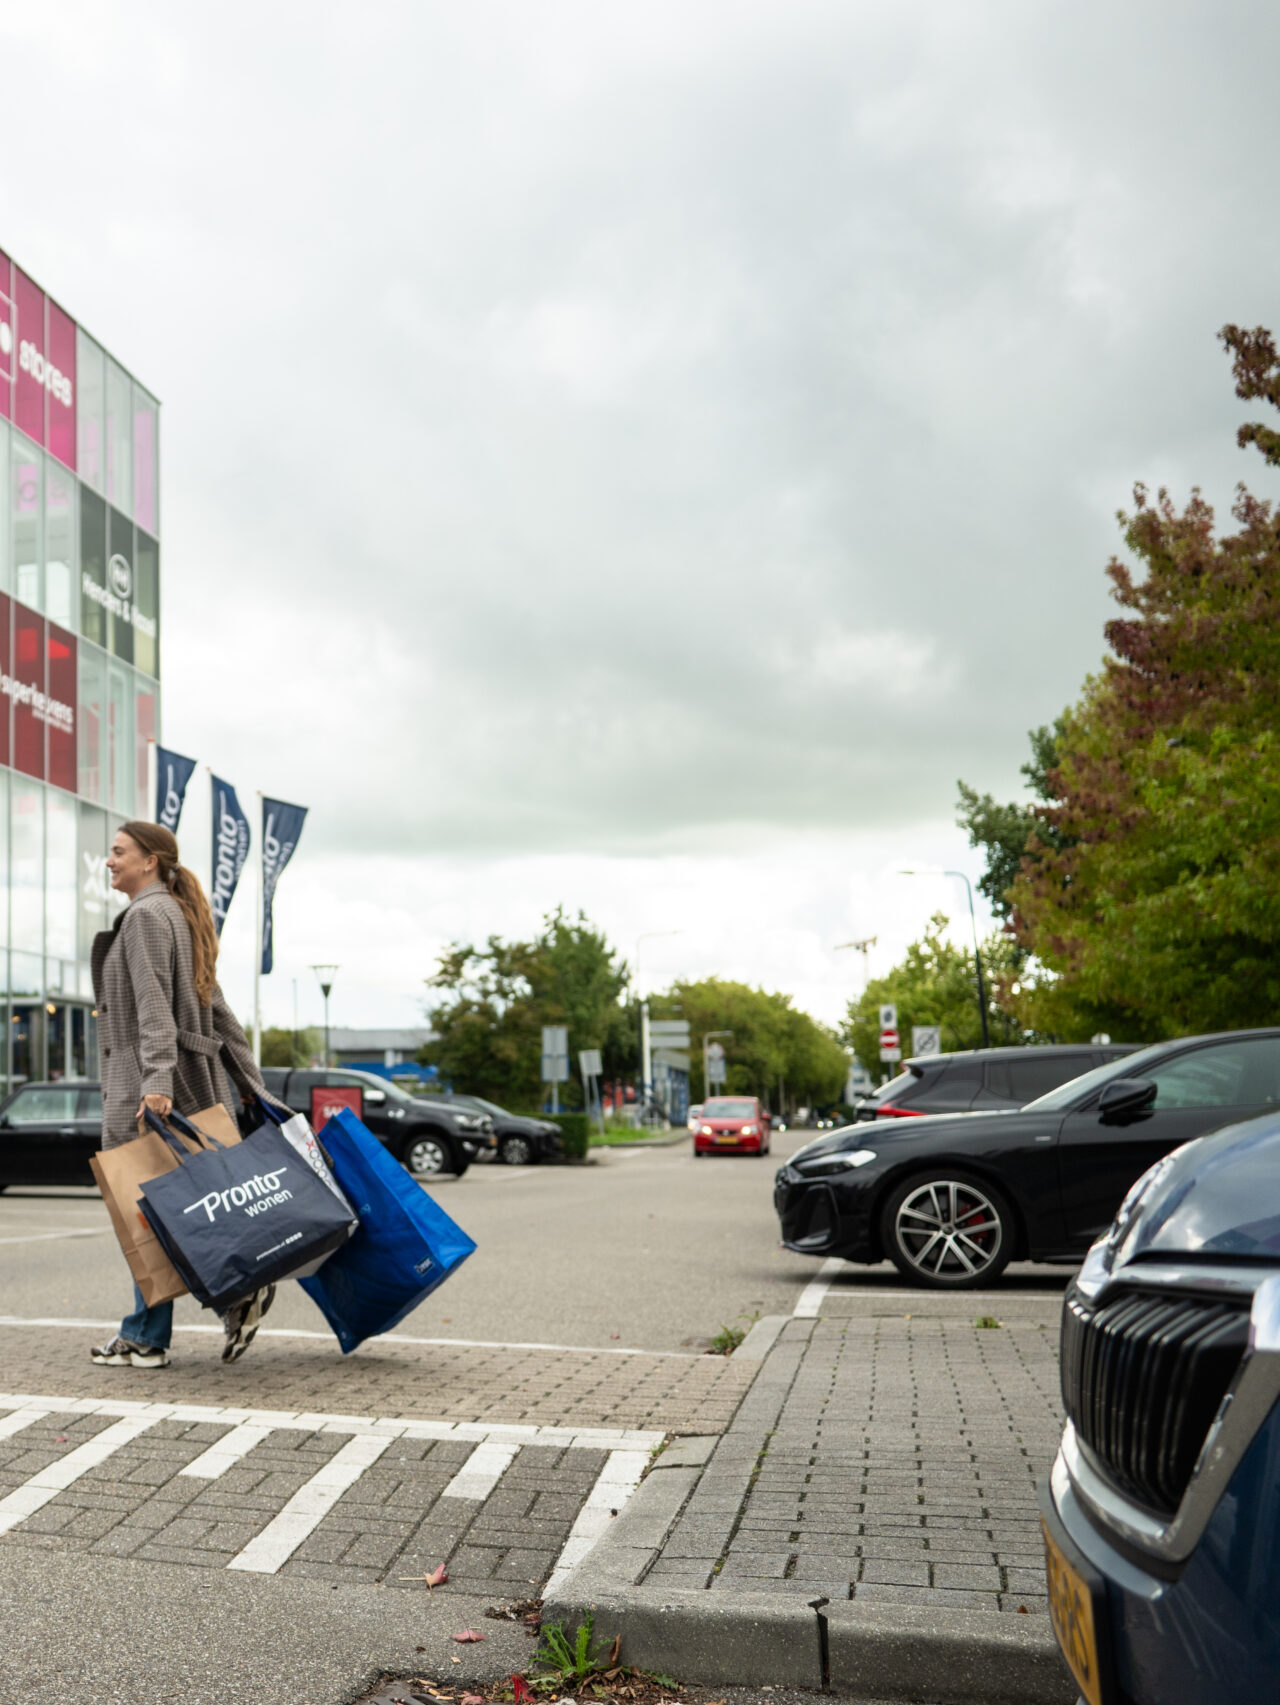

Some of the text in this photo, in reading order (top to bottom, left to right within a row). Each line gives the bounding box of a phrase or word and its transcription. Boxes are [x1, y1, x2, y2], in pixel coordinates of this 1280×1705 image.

[19, 339, 74, 408] stores
[212, 789, 238, 921] Pronto
[183, 1166, 288, 1223] Pronto
[244, 1189, 293, 1218] wonen
